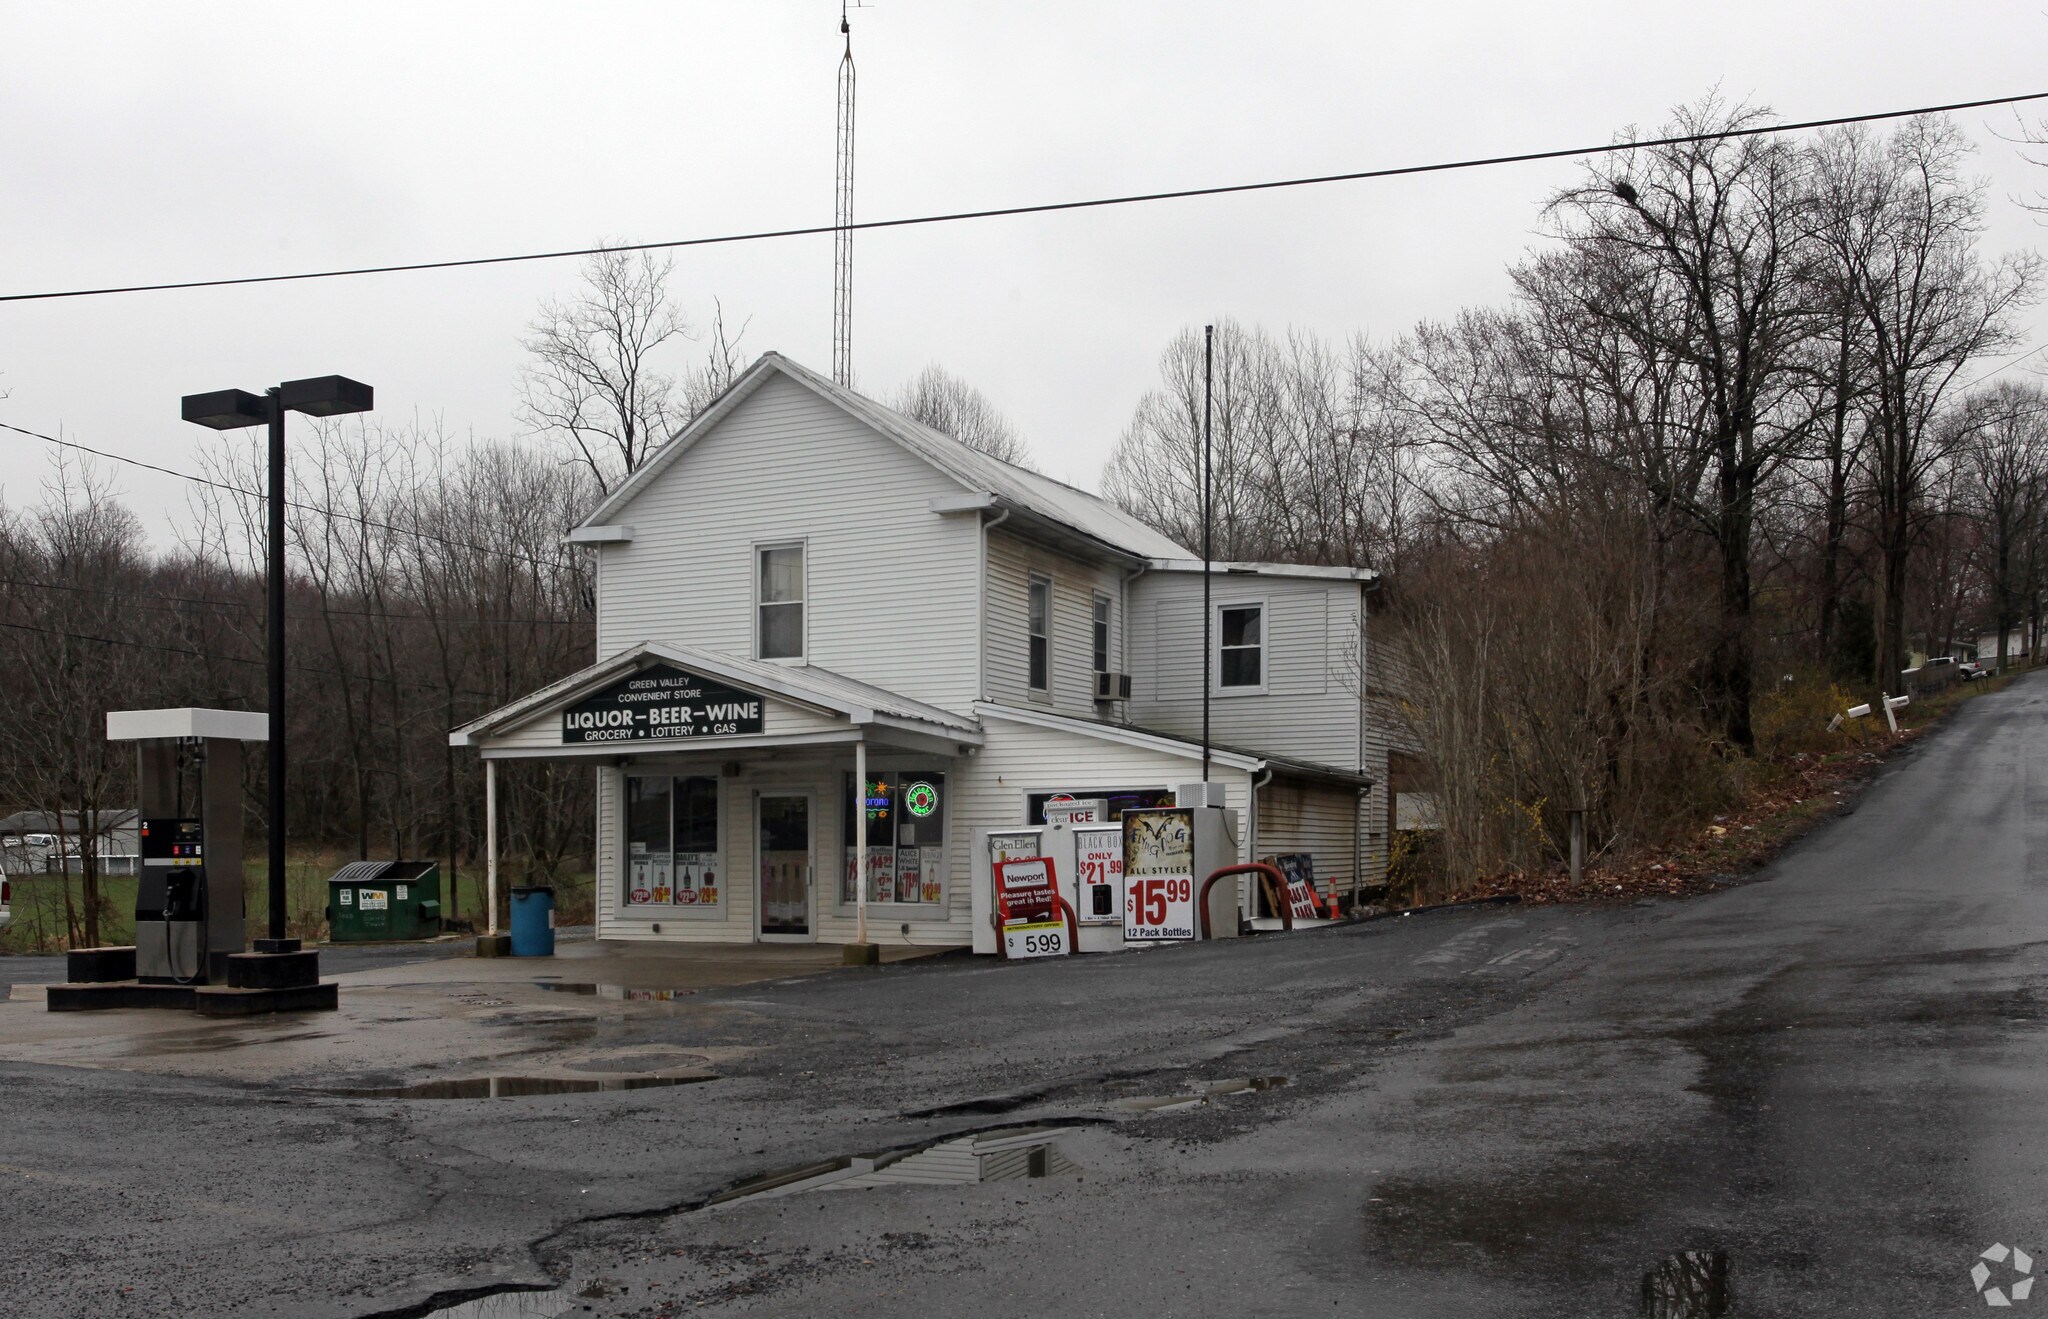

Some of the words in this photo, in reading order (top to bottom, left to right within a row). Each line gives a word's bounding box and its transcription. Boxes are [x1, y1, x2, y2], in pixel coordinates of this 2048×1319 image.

[629, 679, 657, 690] GREEN
[659, 677, 690, 688] VALLEY
[618, 691, 671, 703] CONVENIENT
[674, 689, 702, 699] STORE
[566, 709, 634, 730] LIQUOR
[649, 705, 692, 725] BEER
[705, 702, 759, 721] WINE
[584, 729, 633, 741] GROCERY
[650, 725, 695, 738] LOTTERY
[713, 723, 737, 734] GAS
[908, 786, 935, 804] Heineken
[912, 804, 930, 814] Beer
[1051, 816, 1068, 824] clear
[1070, 811, 1094, 823] ICE
[142, 821, 148, 829] 2
[992, 839, 1014, 851] Glen
[1014, 838, 1036, 850] Ellen
[1079, 835, 1104, 849] BLACK
[899, 849, 917, 857] ALICE
[1087, 852, 1113, 860] ONLY
[898, 857, 919, 865] WHITE
[1080, 859, 1122, 885] $21.99
[1130, 867, 1147, 875] ALL
[1151, 866, 1188, 874] STYLES
[1006, 872, 1045, 883] Newport
[361, 892, 385, 900] WM
[1000, 890, 1032, 899] Pleasure
[1033, 888, 1056, 896] tastes
[1006, 897, 1026, 907] great
[1027, 896, 1034, 904] in
[1035, 895, 1052, 903] Red!
[1006, 923, 1044, 931] INTRODUCTORY
[1127, 928, 1138, 937] 12
[1139, 927, 1160, 937] Pack
[1162, 927, 1192, 937] Bottles
